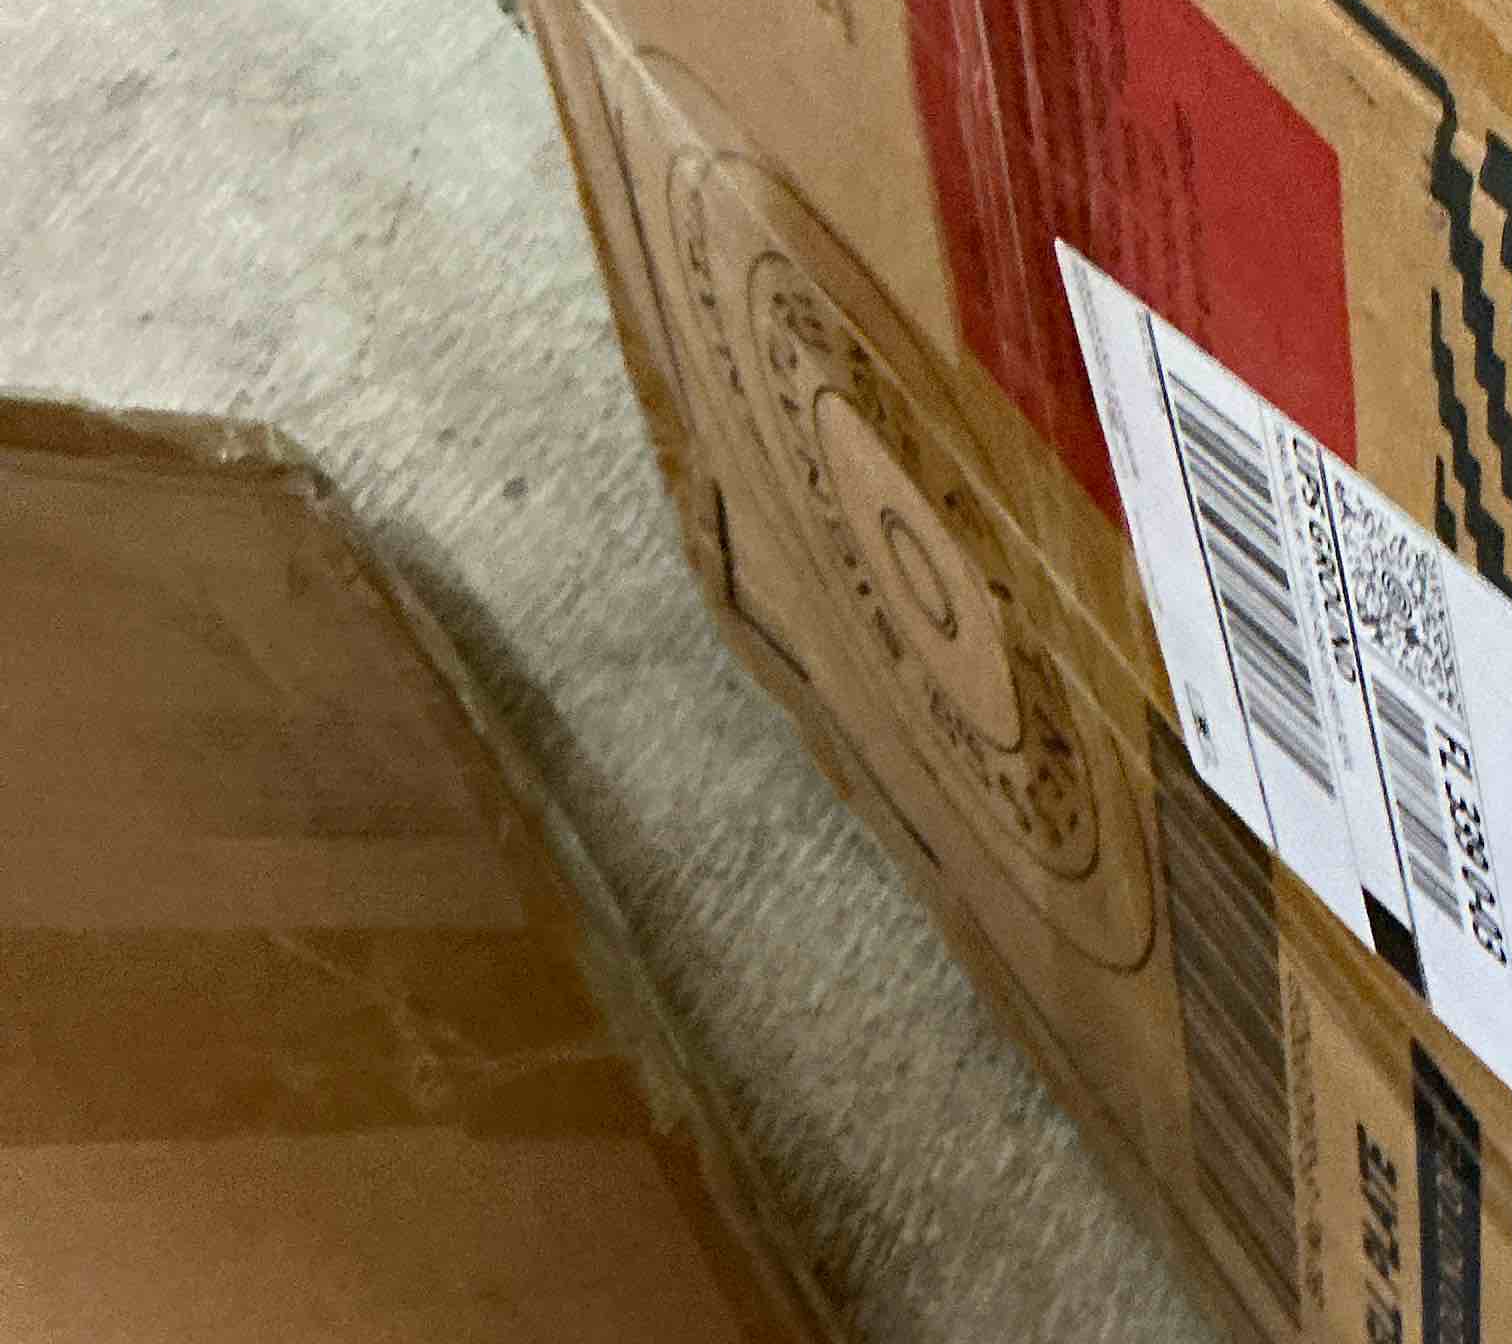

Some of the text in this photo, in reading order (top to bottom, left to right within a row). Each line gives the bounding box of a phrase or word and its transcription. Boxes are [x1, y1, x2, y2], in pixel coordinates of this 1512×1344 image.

[1291, 435, 1322, 511] UPS
[1307, 517, 1358, 688] GROUND
[1434, 722, 1472, 785] FL
